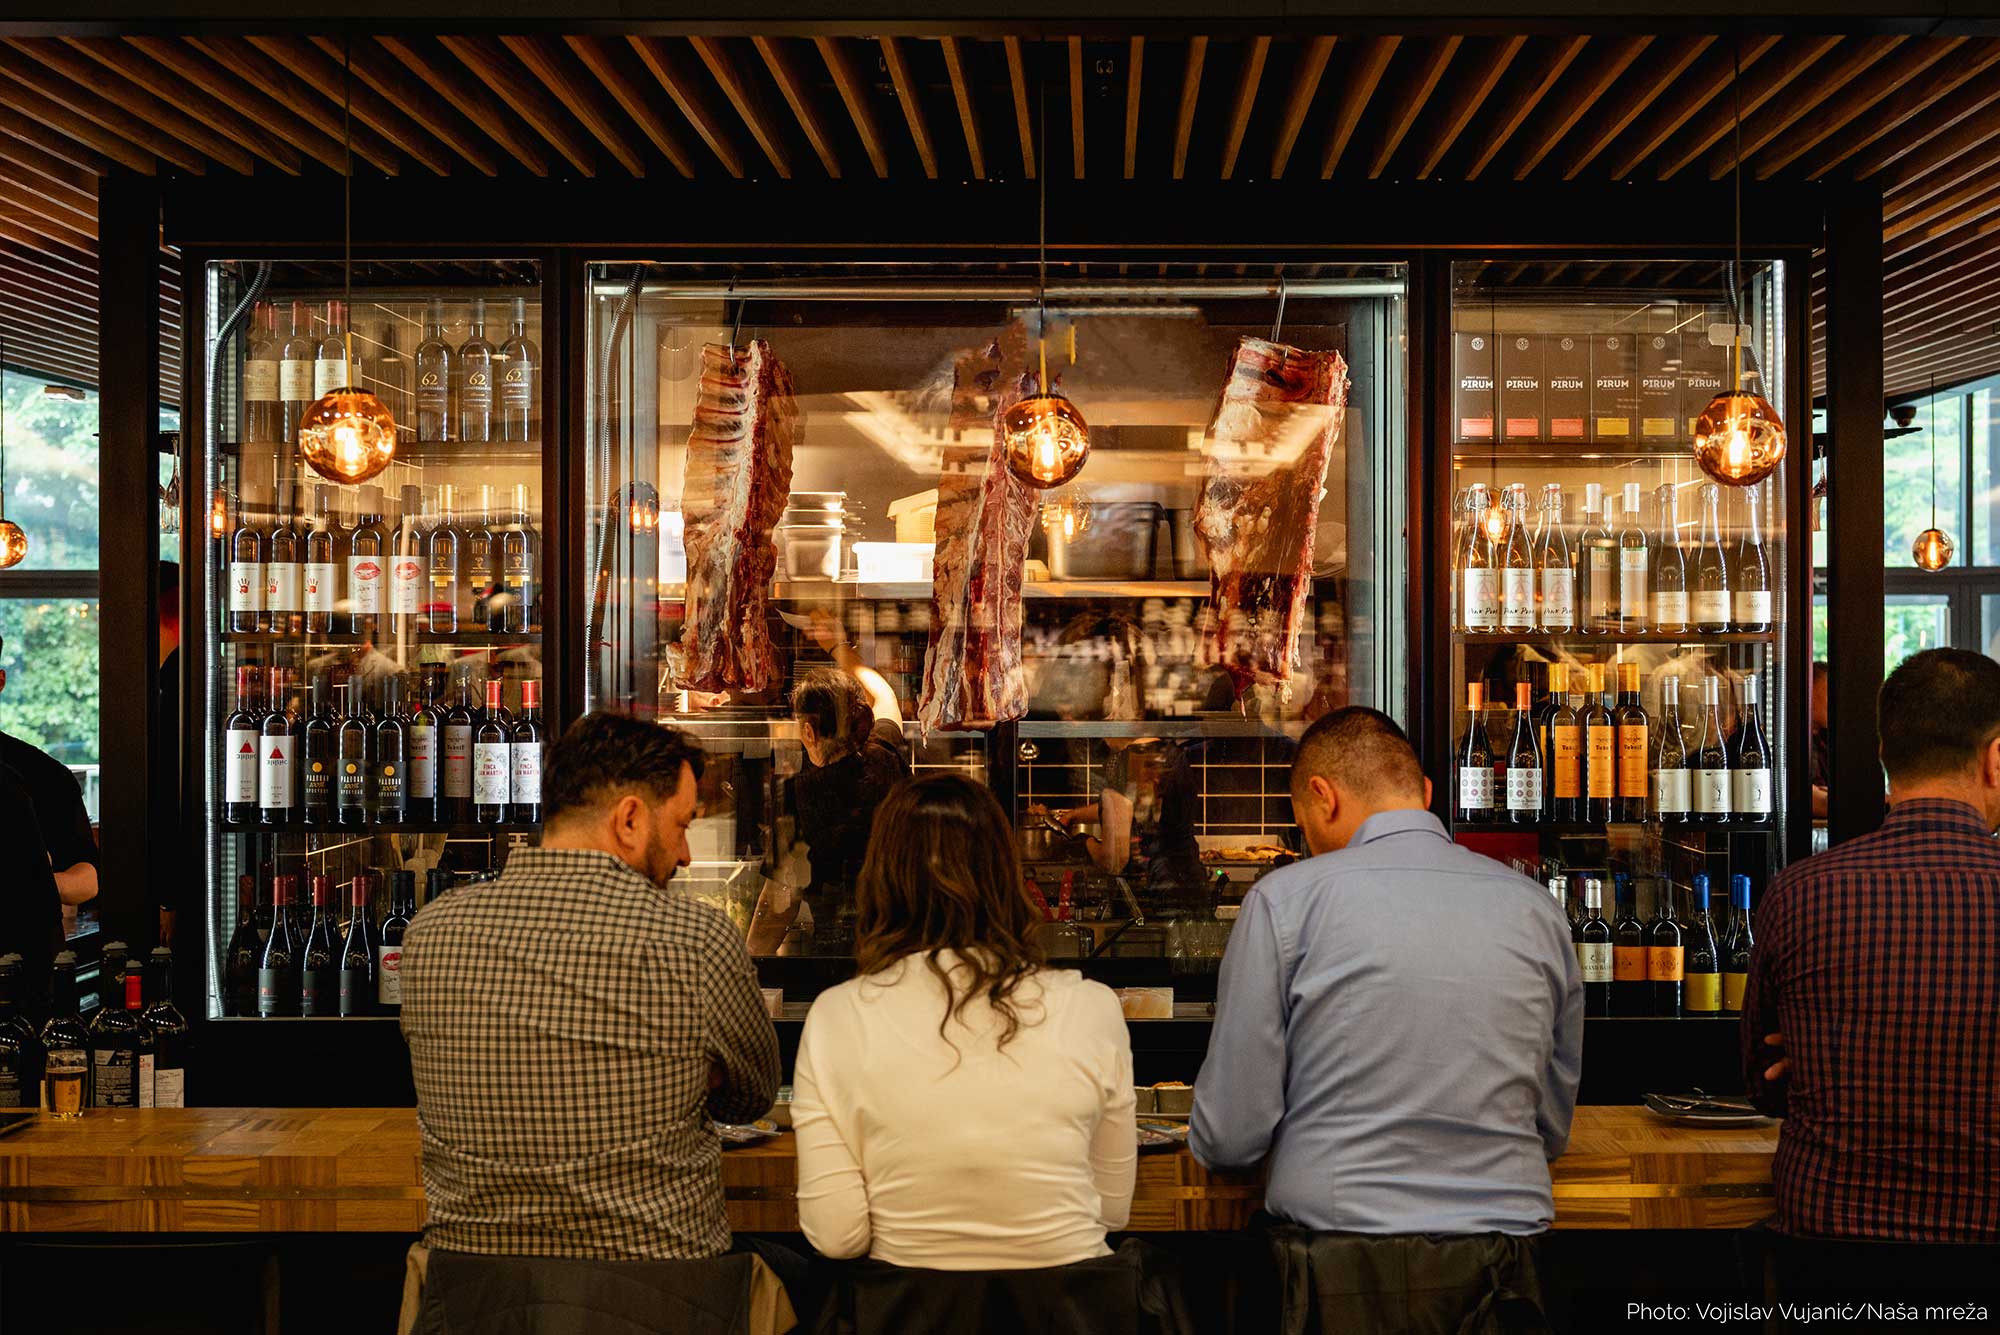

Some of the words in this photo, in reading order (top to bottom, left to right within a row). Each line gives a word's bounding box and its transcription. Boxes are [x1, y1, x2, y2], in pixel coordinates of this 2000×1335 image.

[421, 371, 438, 386] 62
[468, 371, 486, 386] 62
[505, 368, 522, 382] 62
[1461, 380, 1494, 389] PIRUM
[1506, 380, 1539, 389] PIRUM
[1551, 380, 1583, 389] PIRUM
[1596, 379, 1629, 388] PIRUM
[1642, 379, 1675, 388] PIRUM
[1688, 379, 1720, 388] PIRUM
